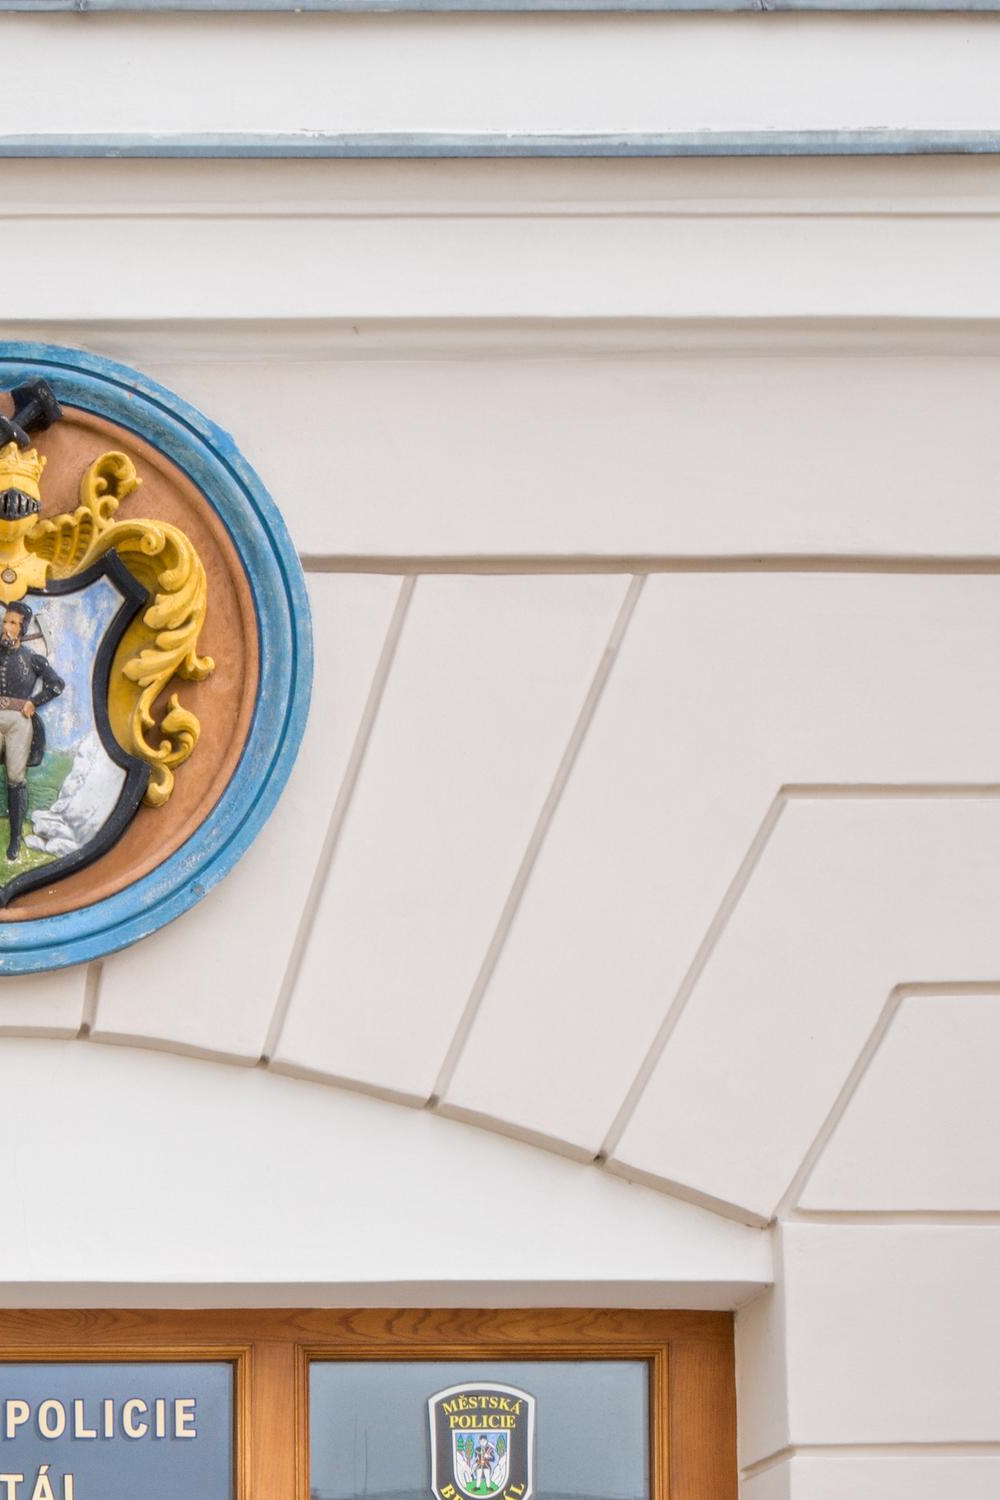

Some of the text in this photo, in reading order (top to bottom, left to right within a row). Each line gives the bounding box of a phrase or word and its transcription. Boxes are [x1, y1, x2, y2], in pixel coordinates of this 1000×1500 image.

[442, 1394, 523, 1416] MĚSTSKÁ
[4, 1397, 198, 1440] POLICIE
[449, 1414, 516, 1429] POLICIE
